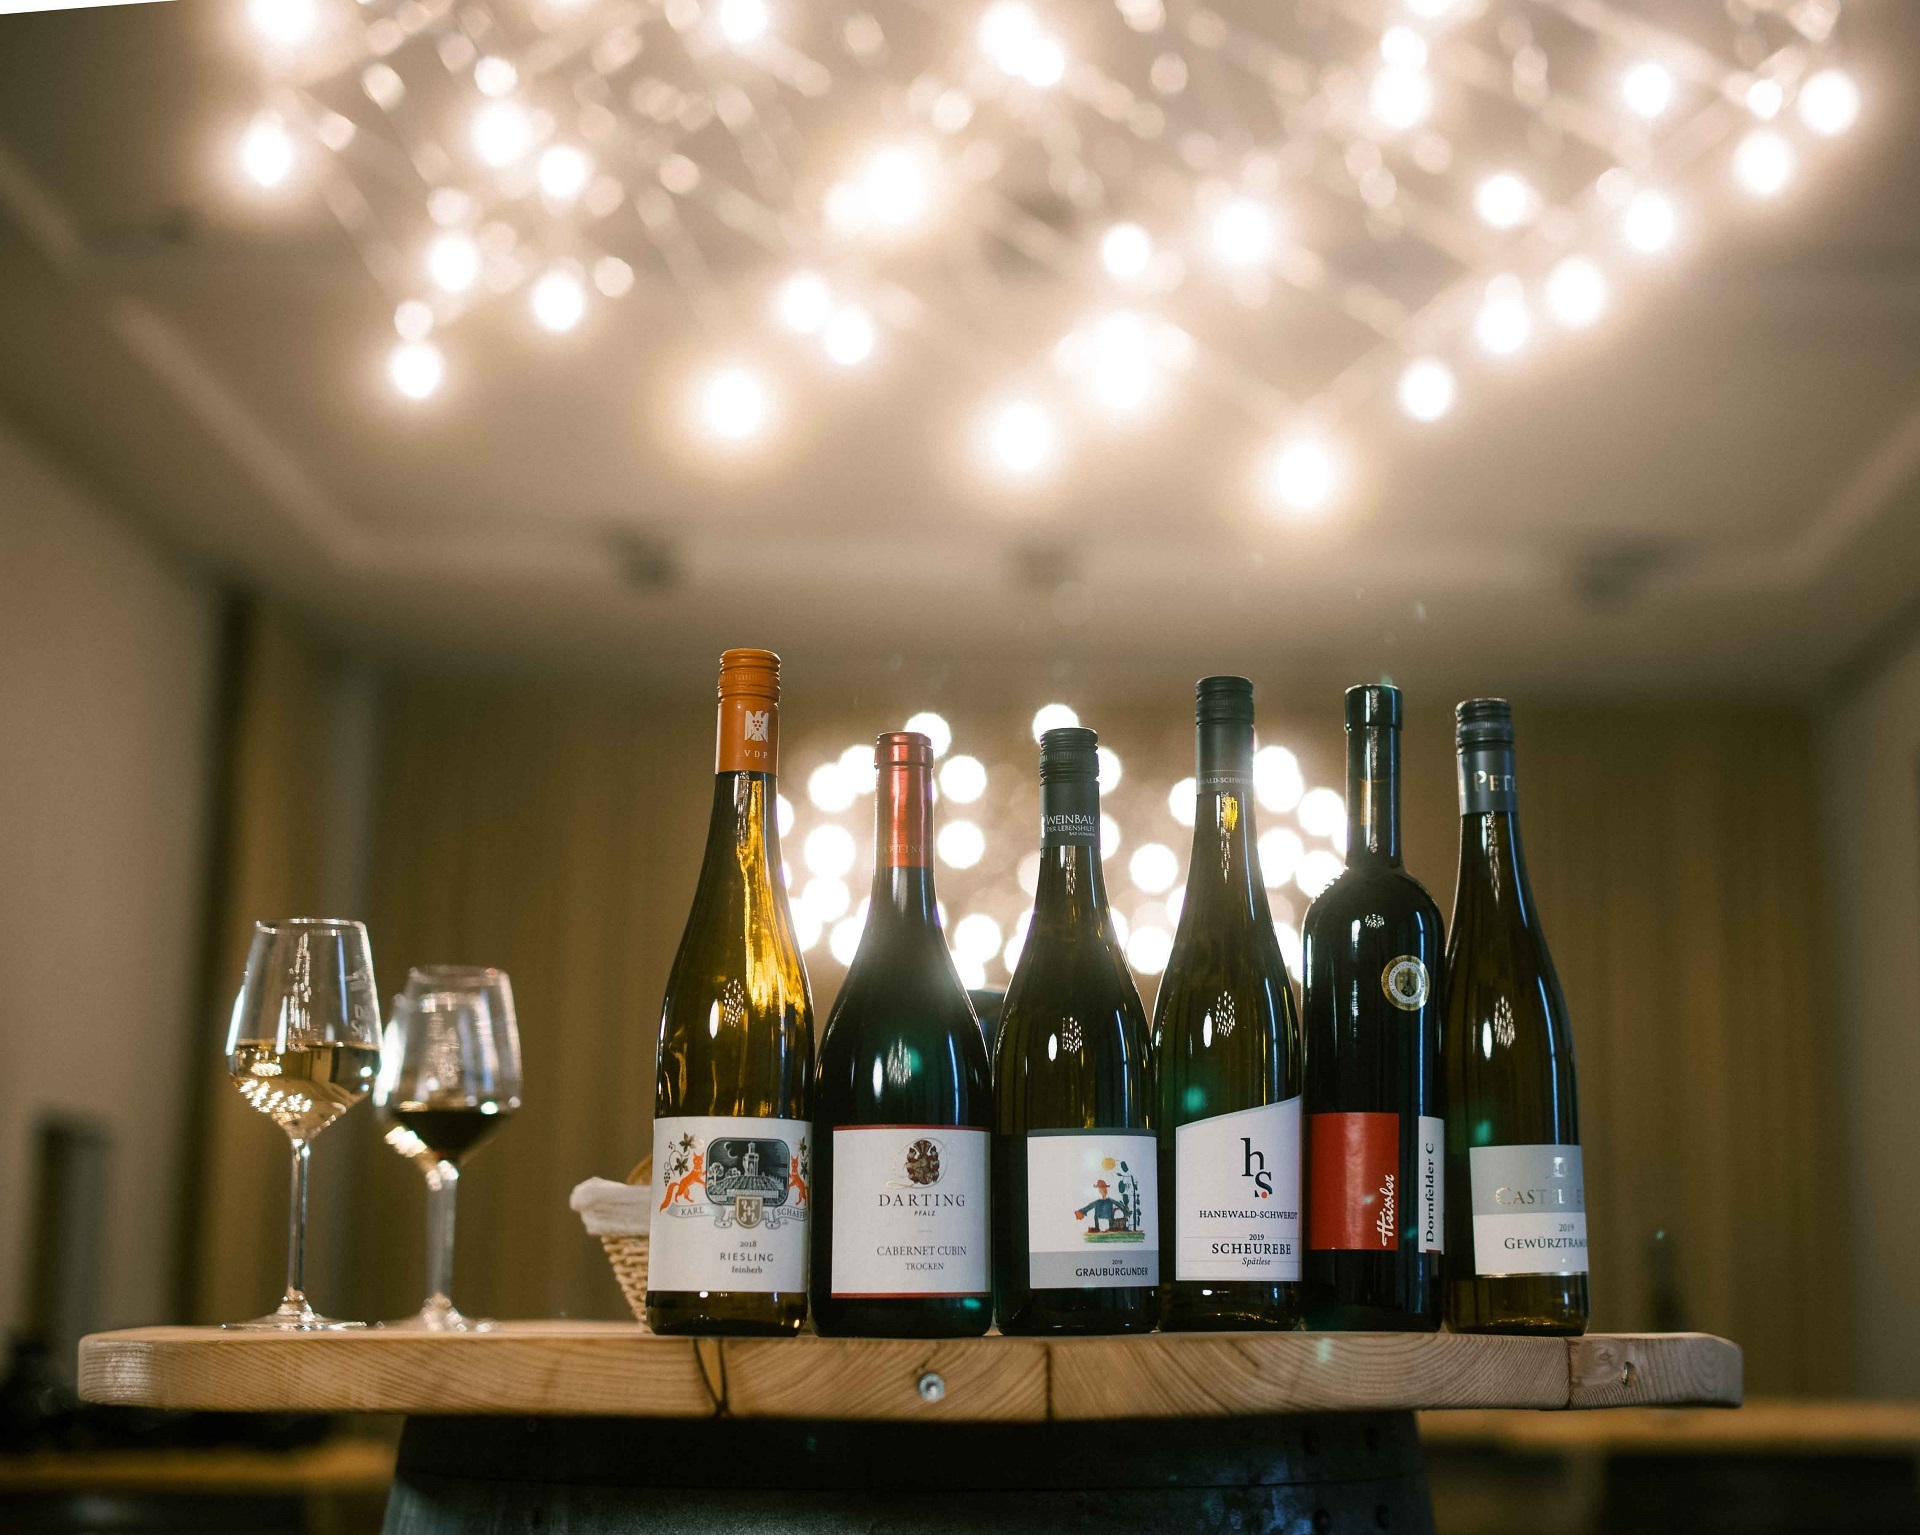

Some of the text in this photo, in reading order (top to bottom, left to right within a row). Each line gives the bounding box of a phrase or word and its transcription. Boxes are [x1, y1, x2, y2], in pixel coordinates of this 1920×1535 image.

[744, 749, 768, 758] VDP
[1045, 814, 1095, 825] WEINBAU
[1425, 1143, 1434, 1242] Dornfelder C
[878, 1194, 965, 1207] DARTING
[680, 1206, 705, 1216] KARL
[1199, 1210, 1298, 1219] HANEWALD-SCHWERDT
[1376, 1173, 1395, 1247] Heissler
[1558, 1223, 1575, 1232] 2019
[1249, 1233, 1265, 1241] 2019
[739, 1240, 757, 1248] 2018
[1211, 1243, 1292, 1255] SCHEUREBE
[876, 1245, 967, 1256] CABERNET CUBIN
[719, 1252, 774, 1262] RIESLING
[1242, 1257, 1271, 1267] Spätlese
[731, 1265, 763, 1274] feinherb
[905, 1262, 944, 1271] TROCKEN
[1075, 1267, 1149, 1277] GRAUBURGUNDER
